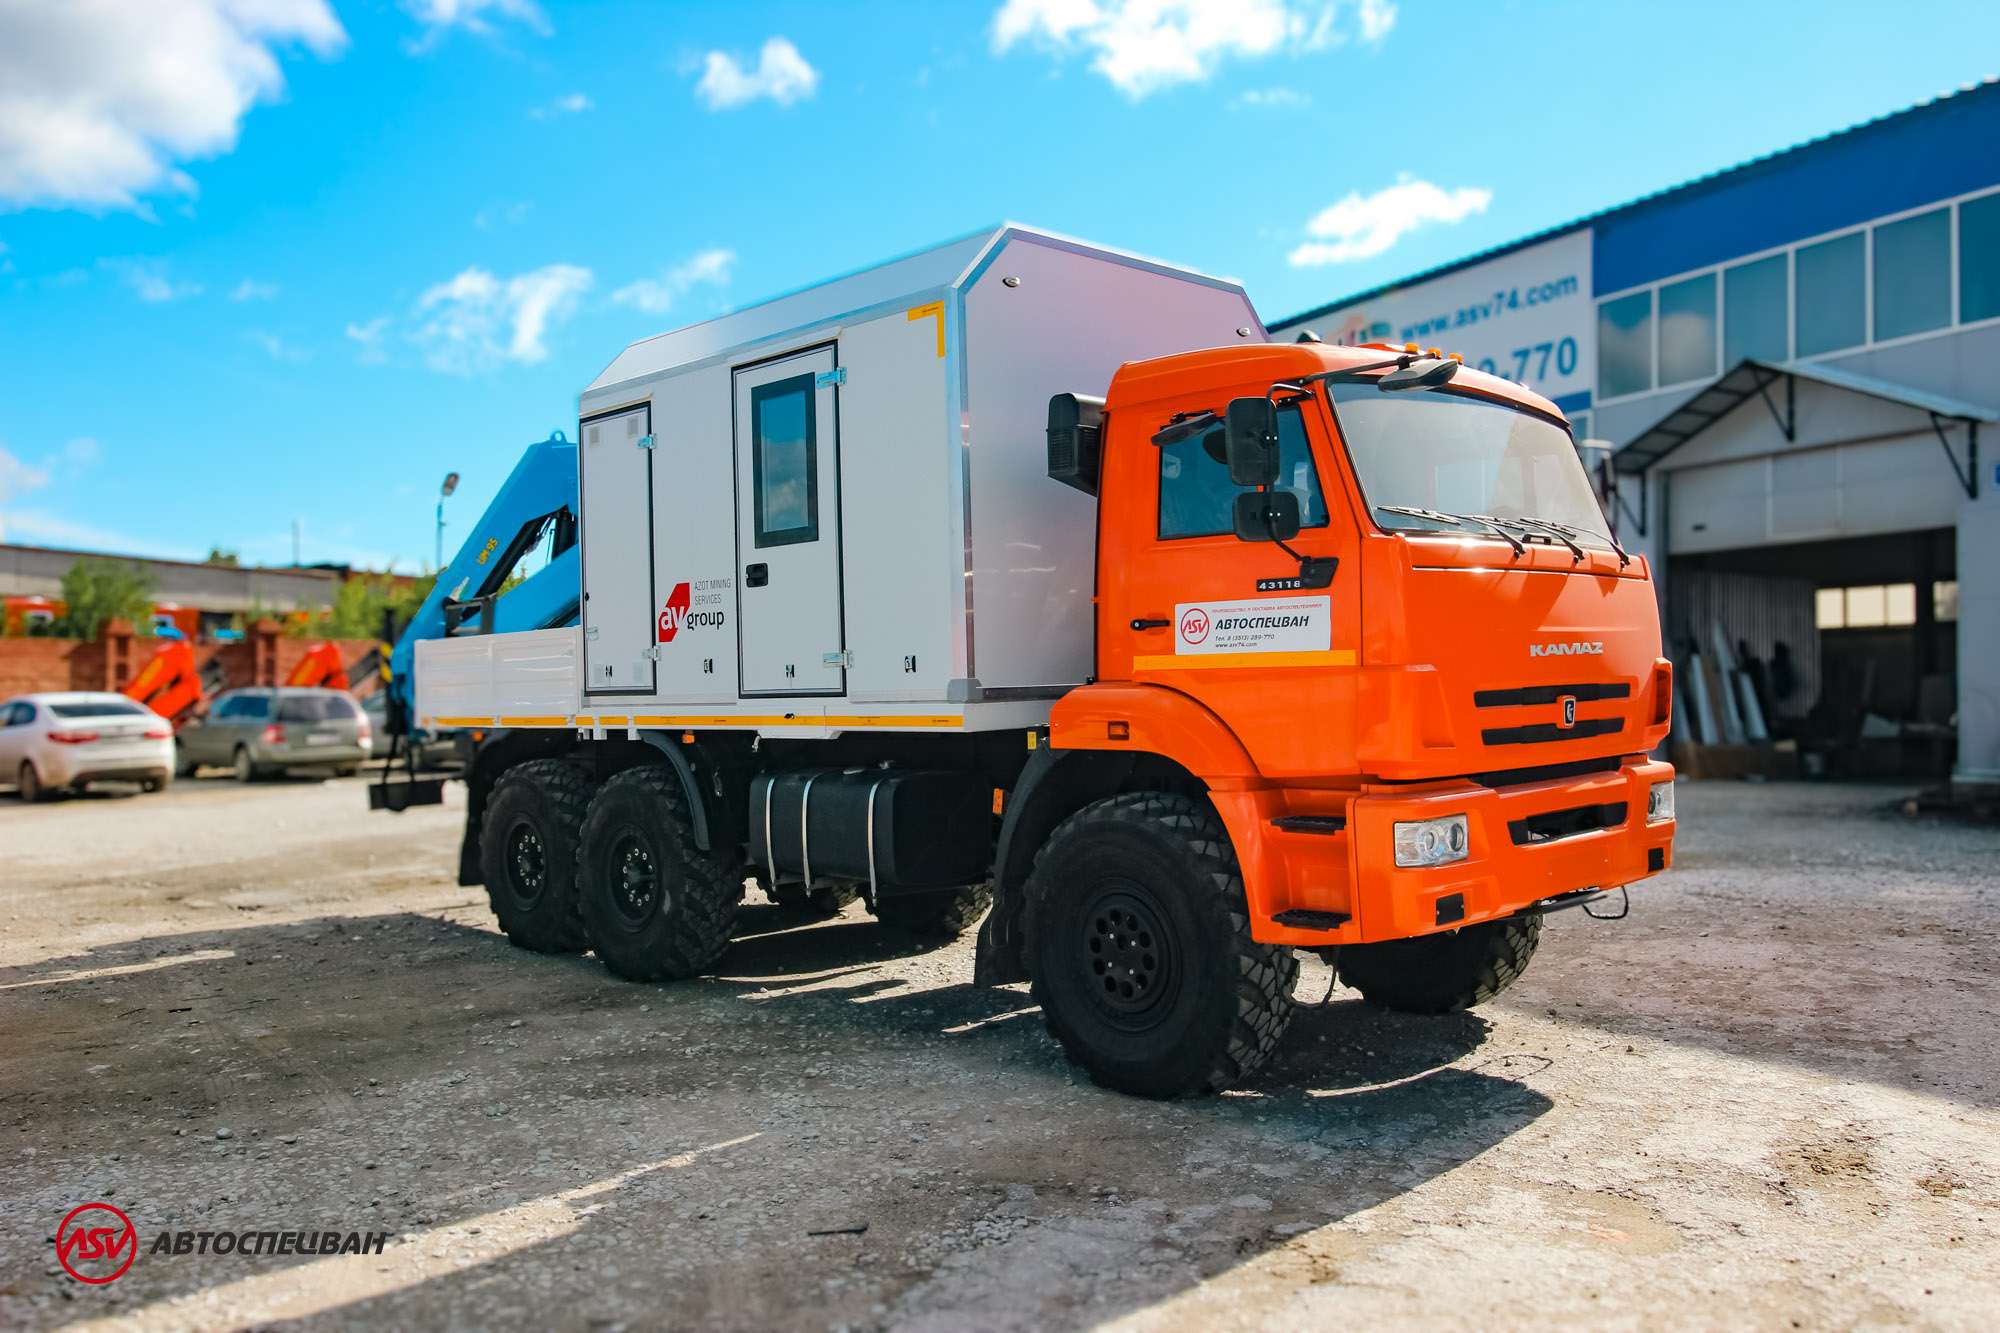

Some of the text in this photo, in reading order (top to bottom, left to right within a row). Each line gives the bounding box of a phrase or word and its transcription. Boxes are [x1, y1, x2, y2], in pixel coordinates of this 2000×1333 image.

[1399, 275, 1578, 341] www.asv74.com
[694, 579, 731, 591] AZOT MINING
[1259, 580, 1302, 590] 43118
[694, 594, 721, 606] SERVICES
[1215, 615, 1310, 630] АВТОСПЕЦВАН
[1530, 641, 1604, 657] KAMAZ
